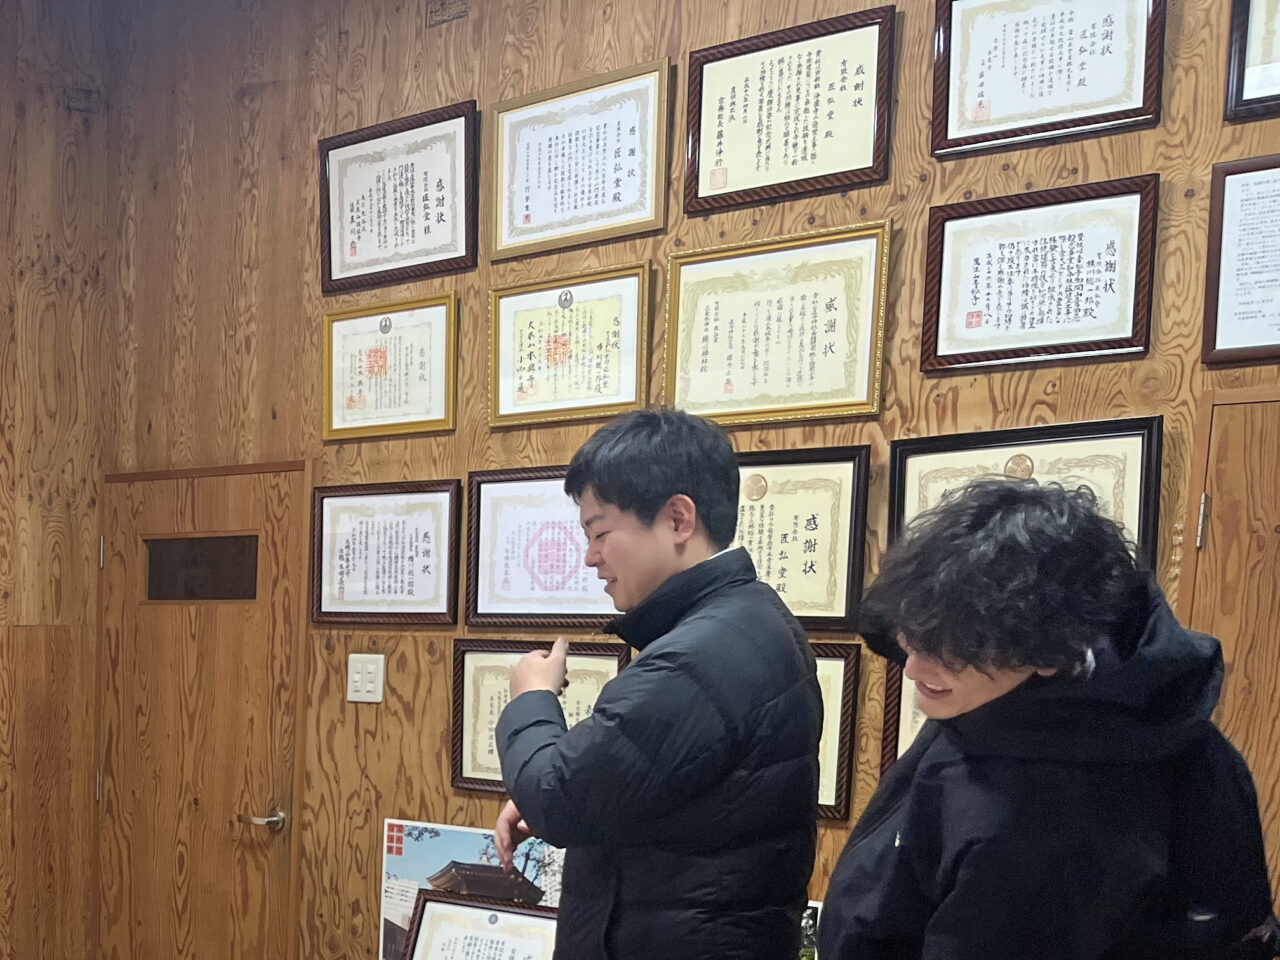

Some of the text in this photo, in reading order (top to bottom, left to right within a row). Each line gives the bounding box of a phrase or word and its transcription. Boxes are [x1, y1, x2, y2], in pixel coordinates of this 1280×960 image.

[1099, 13, 1114, 56] 感謝状
[852, 64, 866, 108] 感謝状
[627, 125, 637, 178] 感謝状
[434, 177, 446, 225] 感謝状
[1103, 239, 1117, 294] 感謝状
[822, 296, 838, 359] 感謝状
[421, 530, 432, 575] 感謝状
[802, 513, 819, 575] 感謝状
